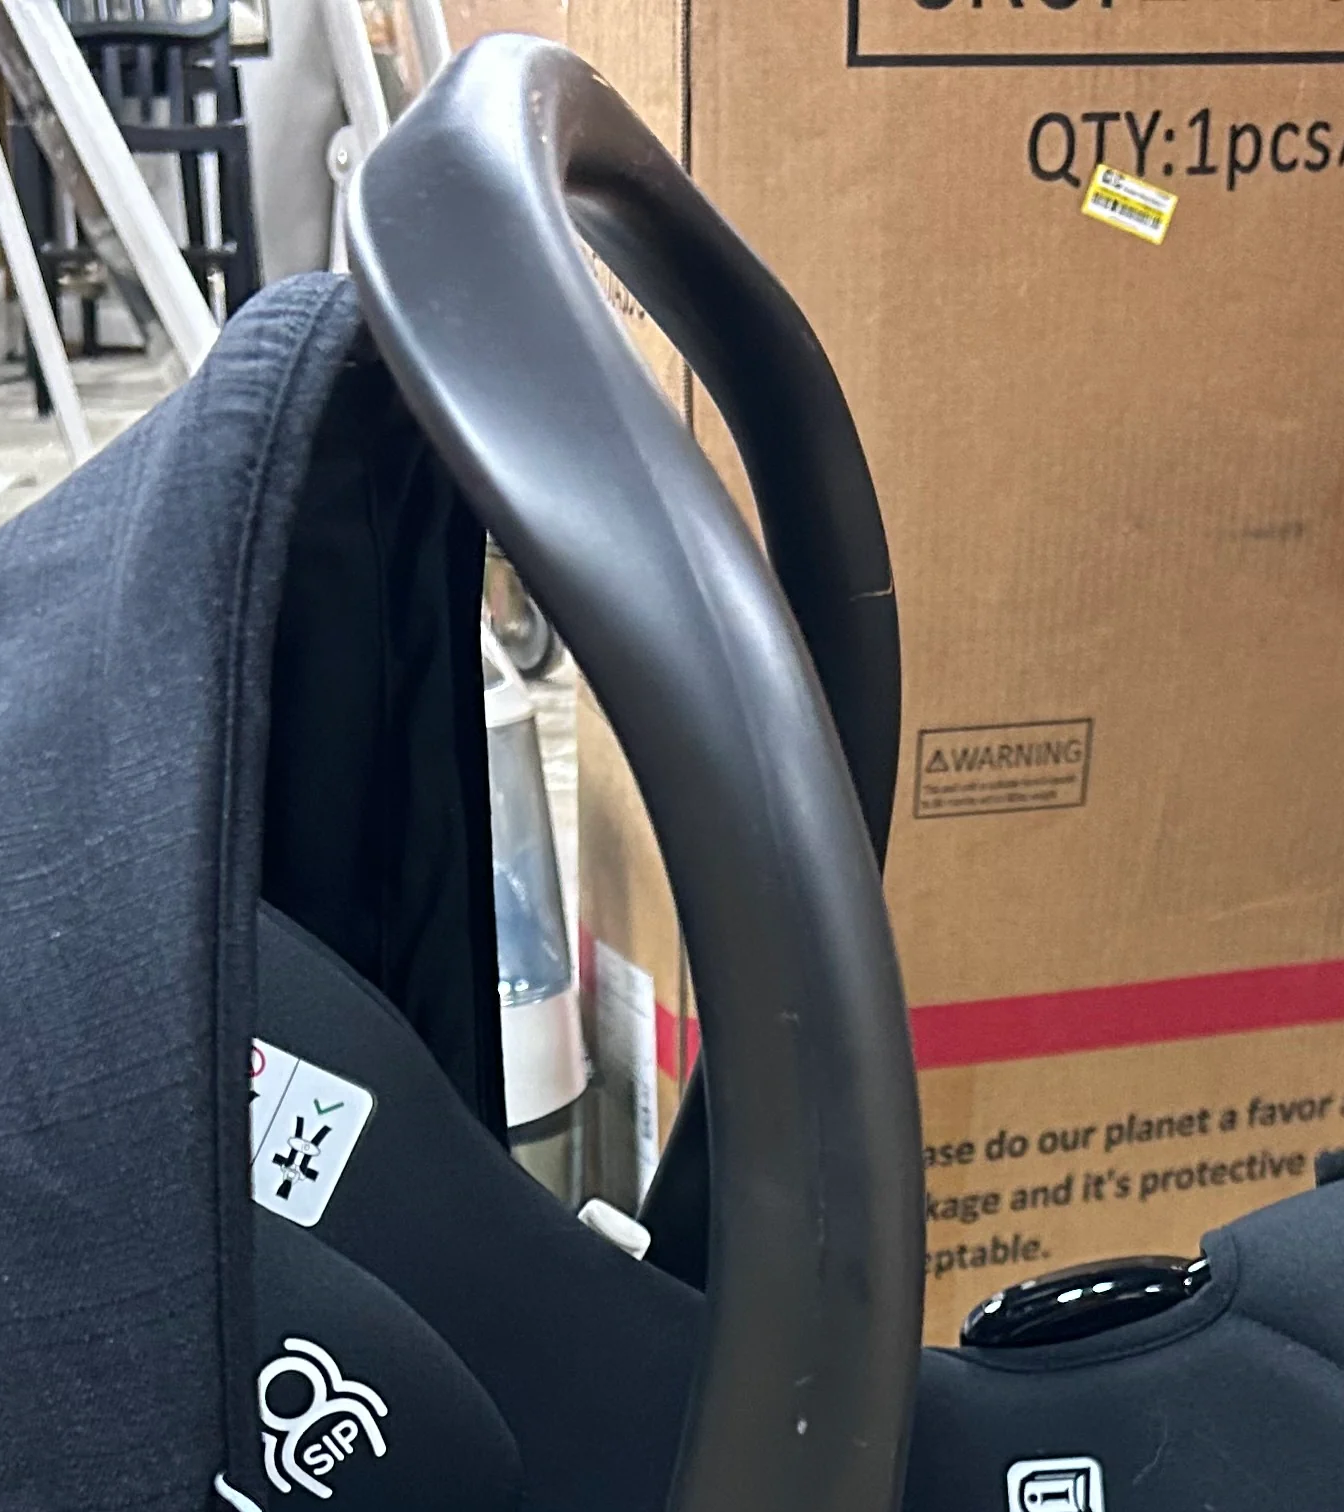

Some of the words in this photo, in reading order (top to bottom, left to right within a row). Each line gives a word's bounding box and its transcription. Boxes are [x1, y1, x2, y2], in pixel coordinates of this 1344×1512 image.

[952, 739, 1083, 772] WARNING
[984, 1130, 1028, 1161] do
[1037, 1124, 1096, 1154] our
[1104, 1106, 1210, 1153] planet
[1218, 1108, 1238, 1132] a
[1247, 1095, 1334, 1128] favor
[1009, 1173, 1073, 1211] and
[1083, 1167, 1131, 1203] it's
[1139, 1152, 1305, 1203] protective
[302, 1418, 359, 1476] SIP
